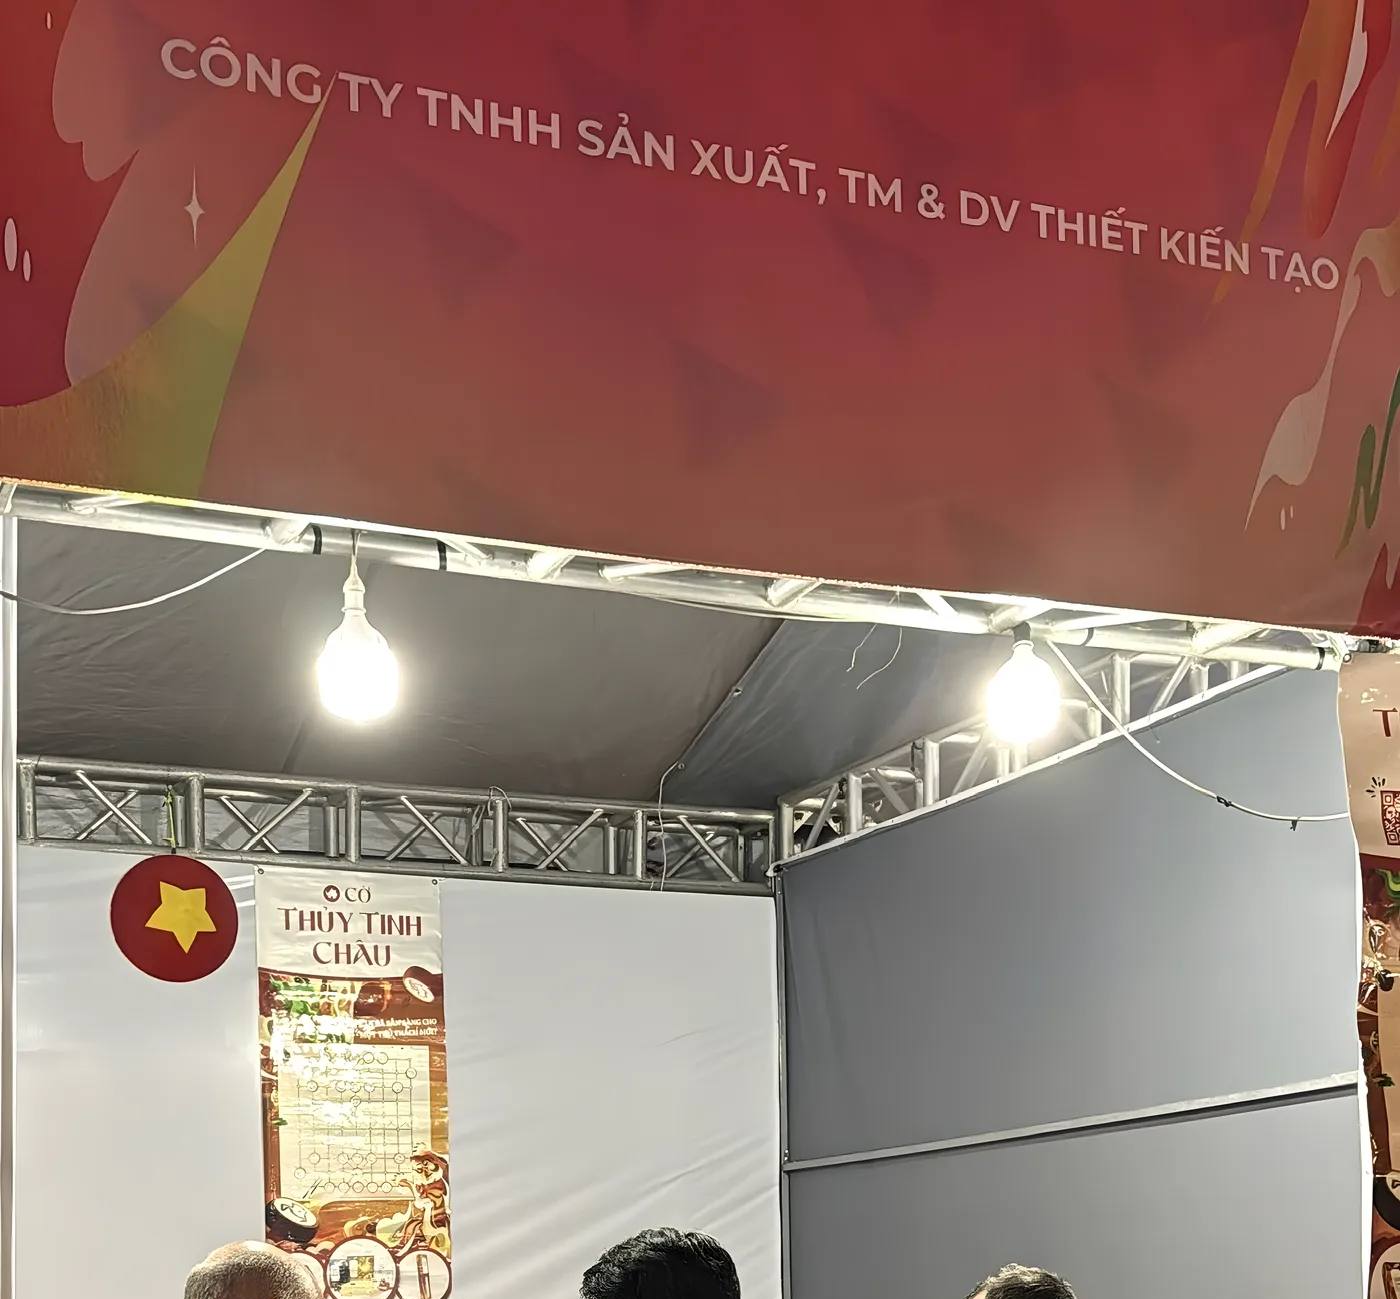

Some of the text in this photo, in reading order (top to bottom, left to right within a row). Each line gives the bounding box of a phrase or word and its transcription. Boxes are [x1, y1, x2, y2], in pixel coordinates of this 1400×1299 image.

[161, 36, 1340, 293] CÔNG TY TNHH SẢN XUẤT, TM & DV THIẾT KIẾN TẠO
[344, 885, 371, 903] CỜ
[277, 906, 422, 936] THỦY TINH
[312, 939, 391, 967] CHÂU
